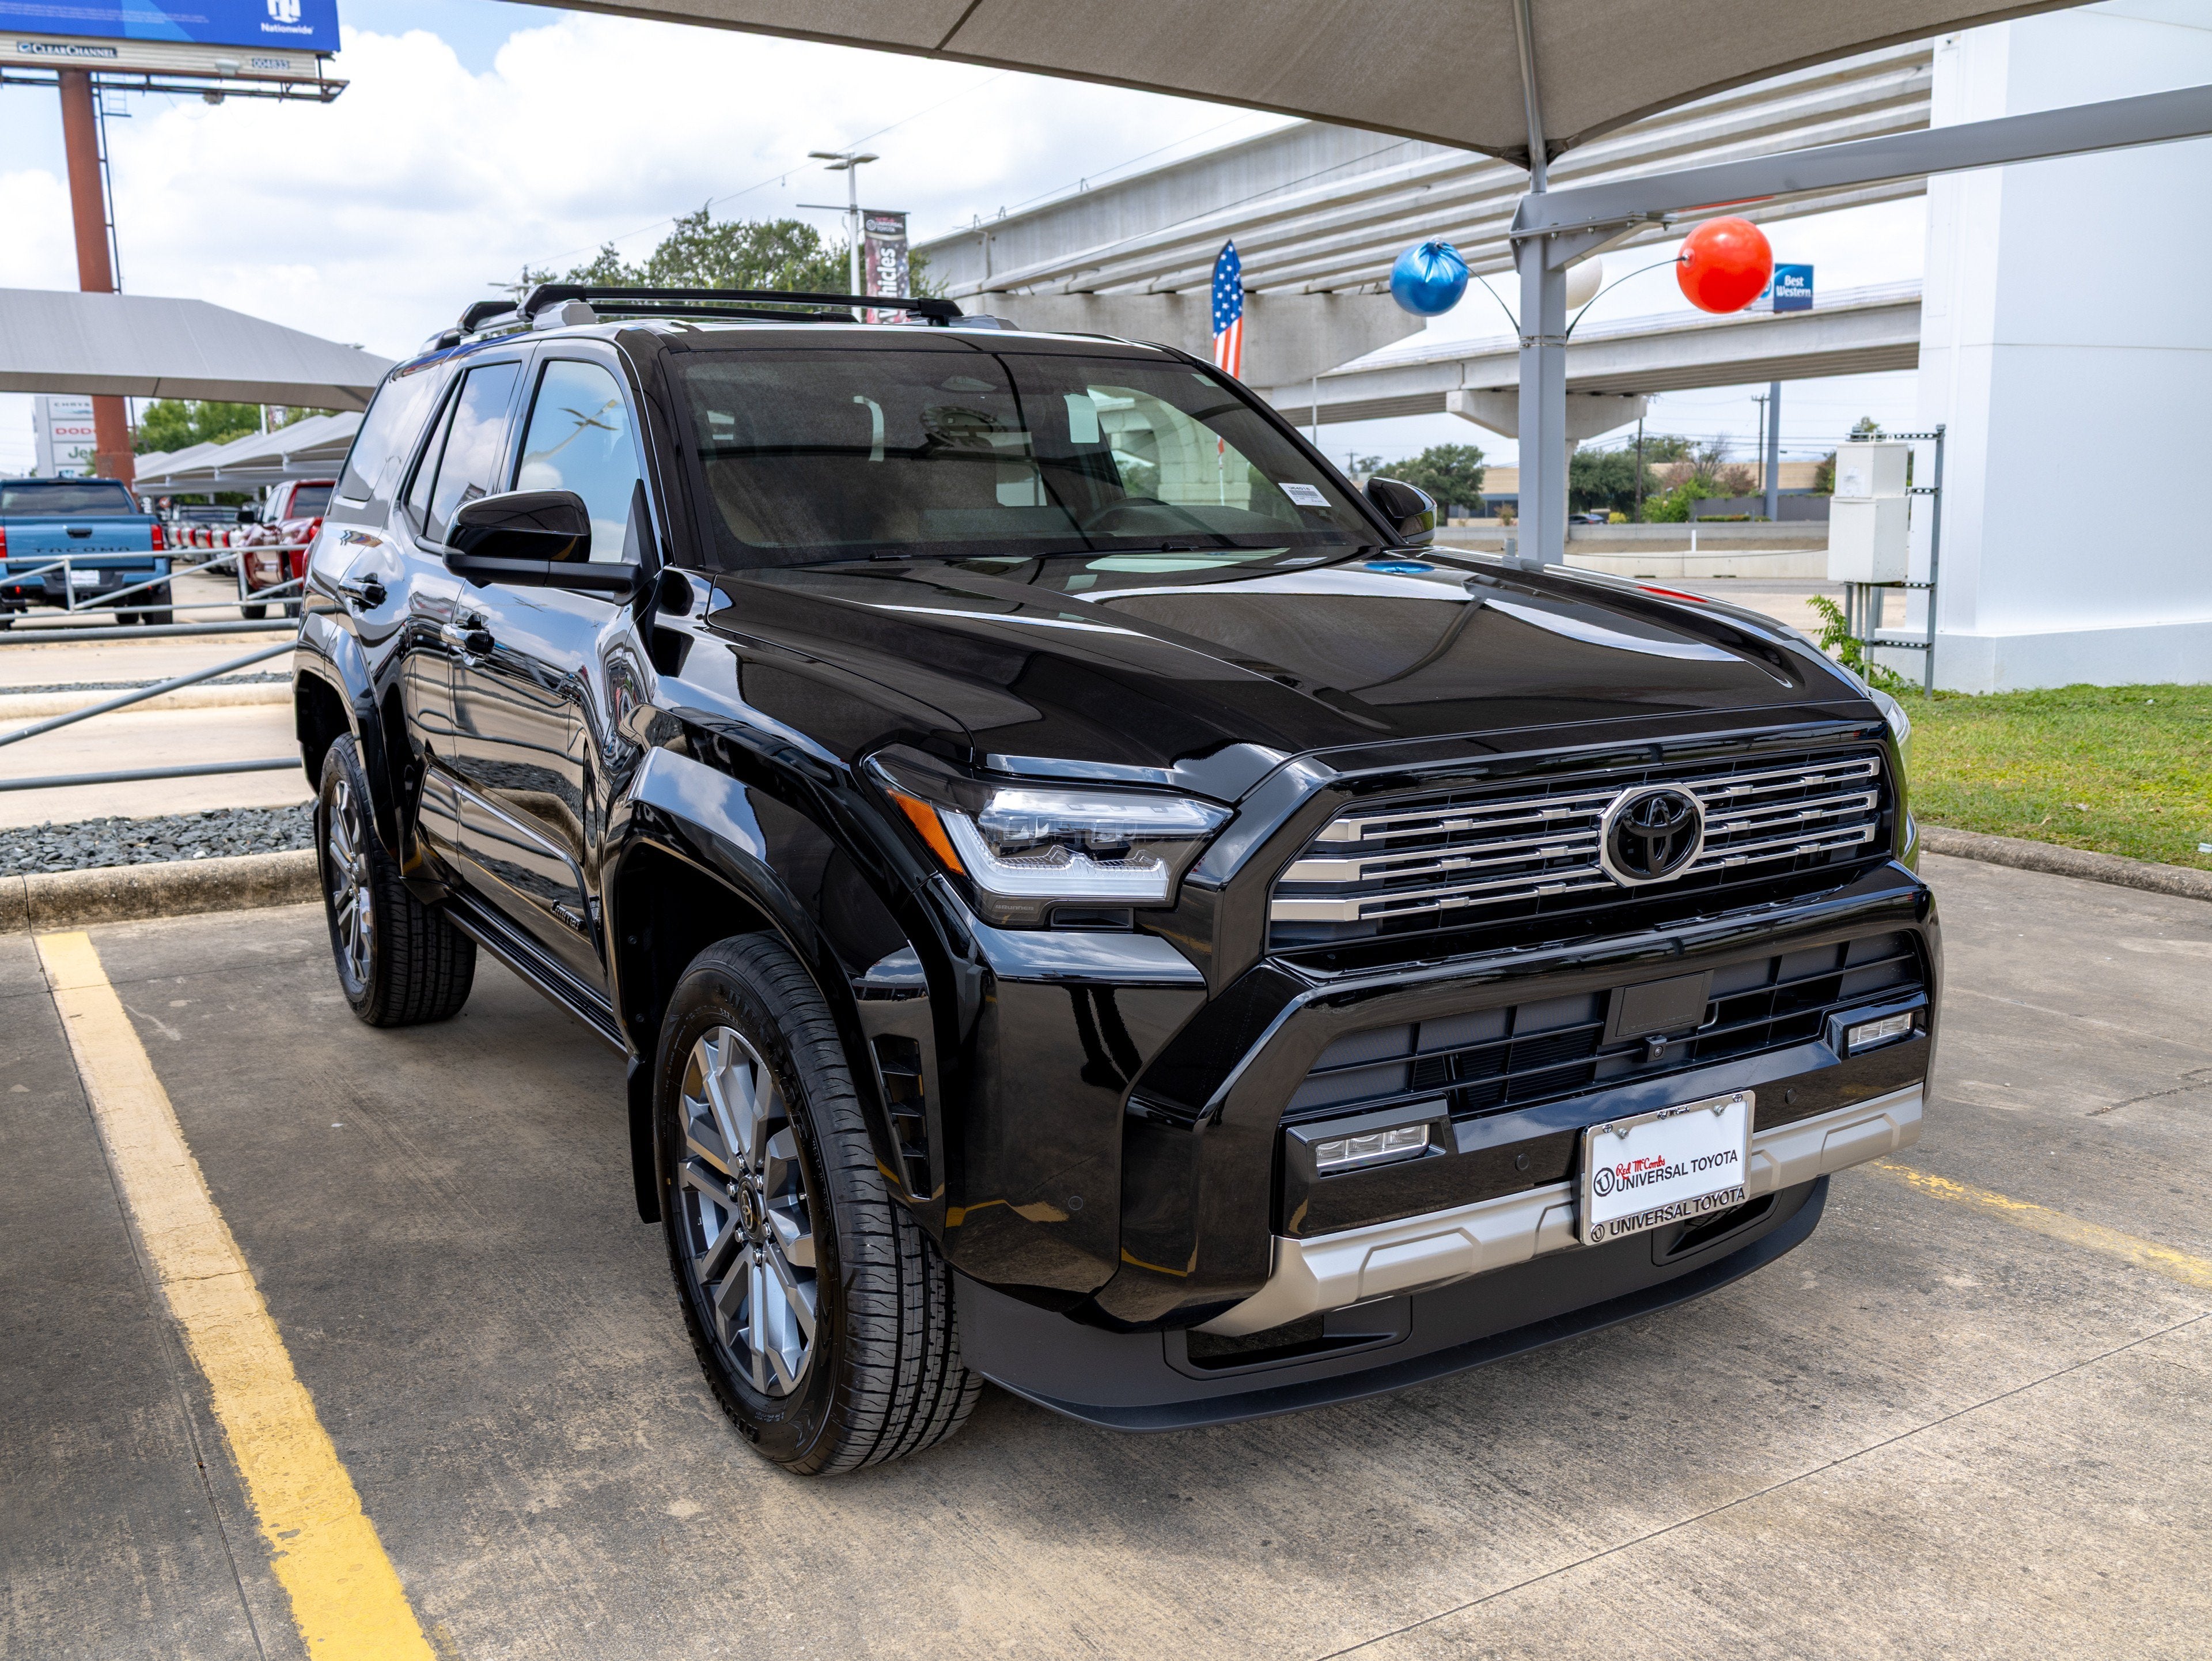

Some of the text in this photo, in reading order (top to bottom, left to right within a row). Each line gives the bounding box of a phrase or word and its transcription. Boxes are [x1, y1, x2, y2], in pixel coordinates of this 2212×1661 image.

[261, 22, 314, 35] Nationwide
[877, 248, 897, 319] Vhicles
[1785, 275, 1804, 287] Best
[1776, 285, 1811, 297] Western
[68, 447, 88, 459] Je
[1616, 1155, 1665, 1179] Red McCombs
[1616, 1149, 1738, 1192] UNIVERSAL TOYOTA
[1609, 1186, 1745, 1235] UNIVERSAL TOYOTA
